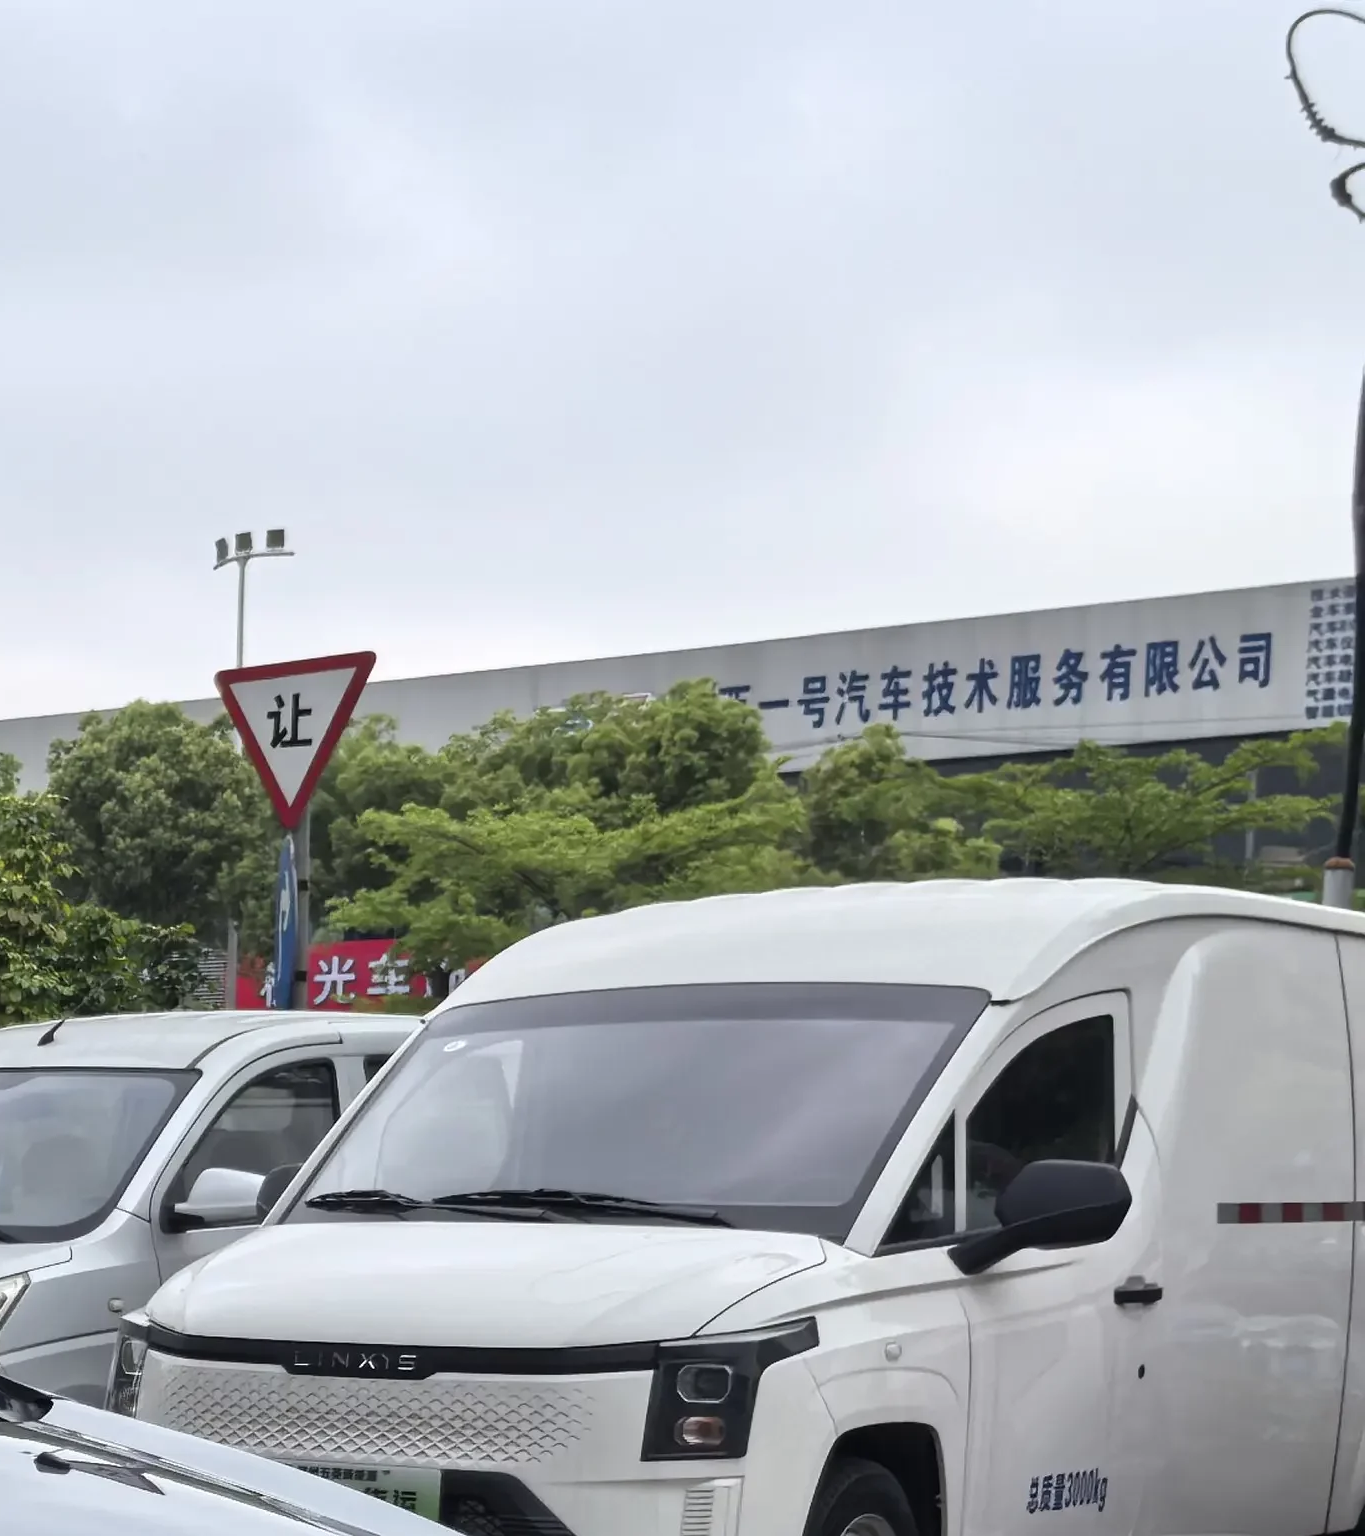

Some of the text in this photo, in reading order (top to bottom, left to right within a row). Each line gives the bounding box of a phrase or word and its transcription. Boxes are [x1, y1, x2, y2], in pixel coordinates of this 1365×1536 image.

[267, 692, 312, 748] 让
[1026, 1468, 1108, 1514] 总质量3000kg
